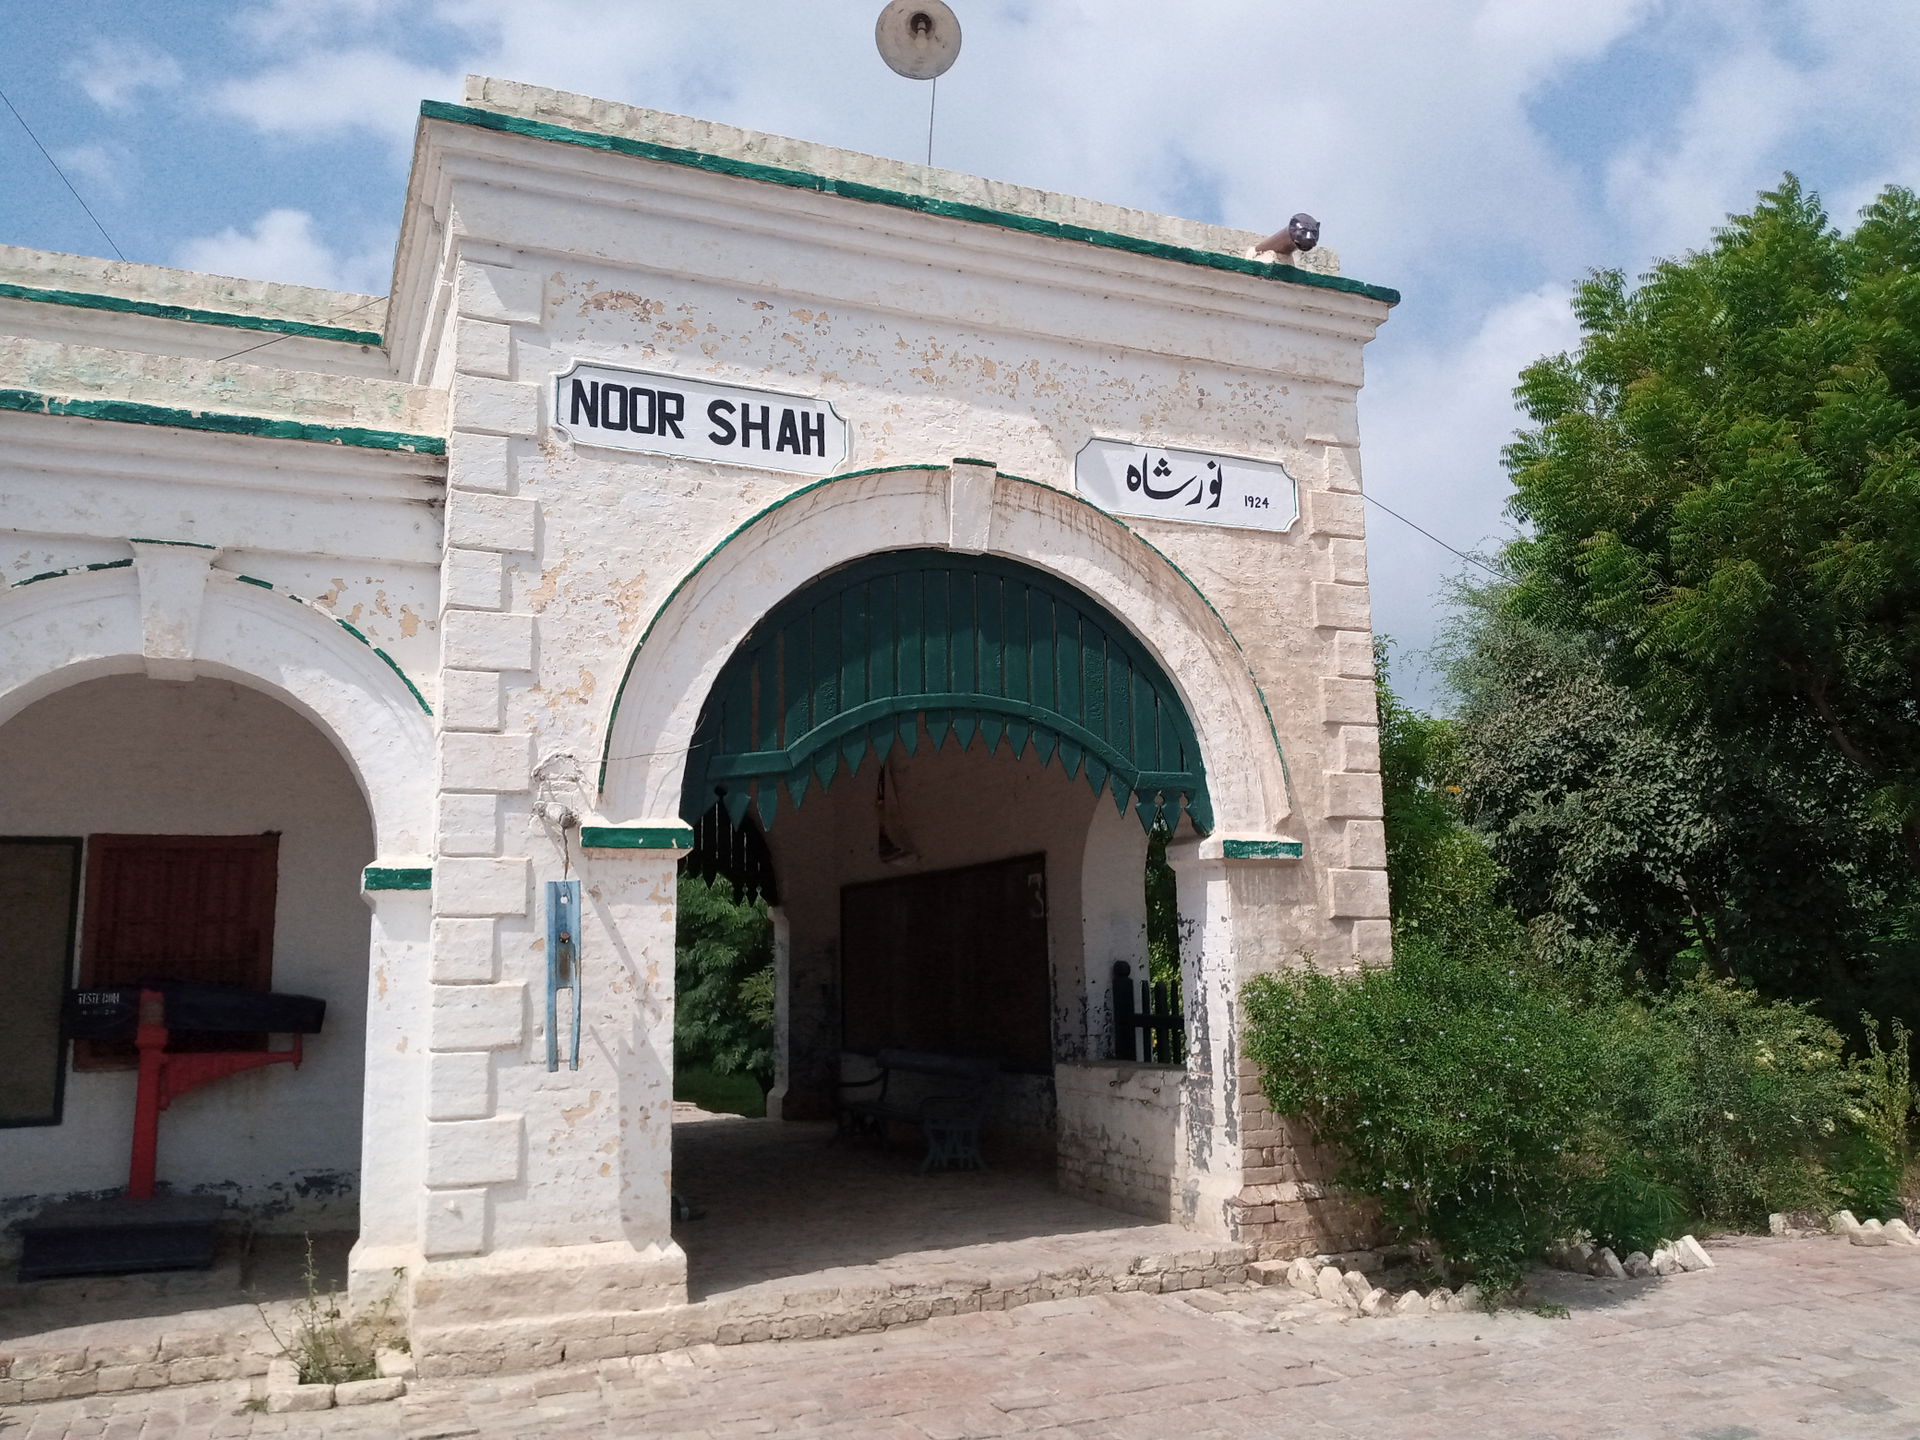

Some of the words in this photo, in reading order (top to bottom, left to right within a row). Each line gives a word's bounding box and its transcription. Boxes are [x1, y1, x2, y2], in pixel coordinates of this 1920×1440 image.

[570, 379, 685, 439] NOOR
[707, 399, 825, 457] SHAH
[1244, 495, 1270, 509] 1924
